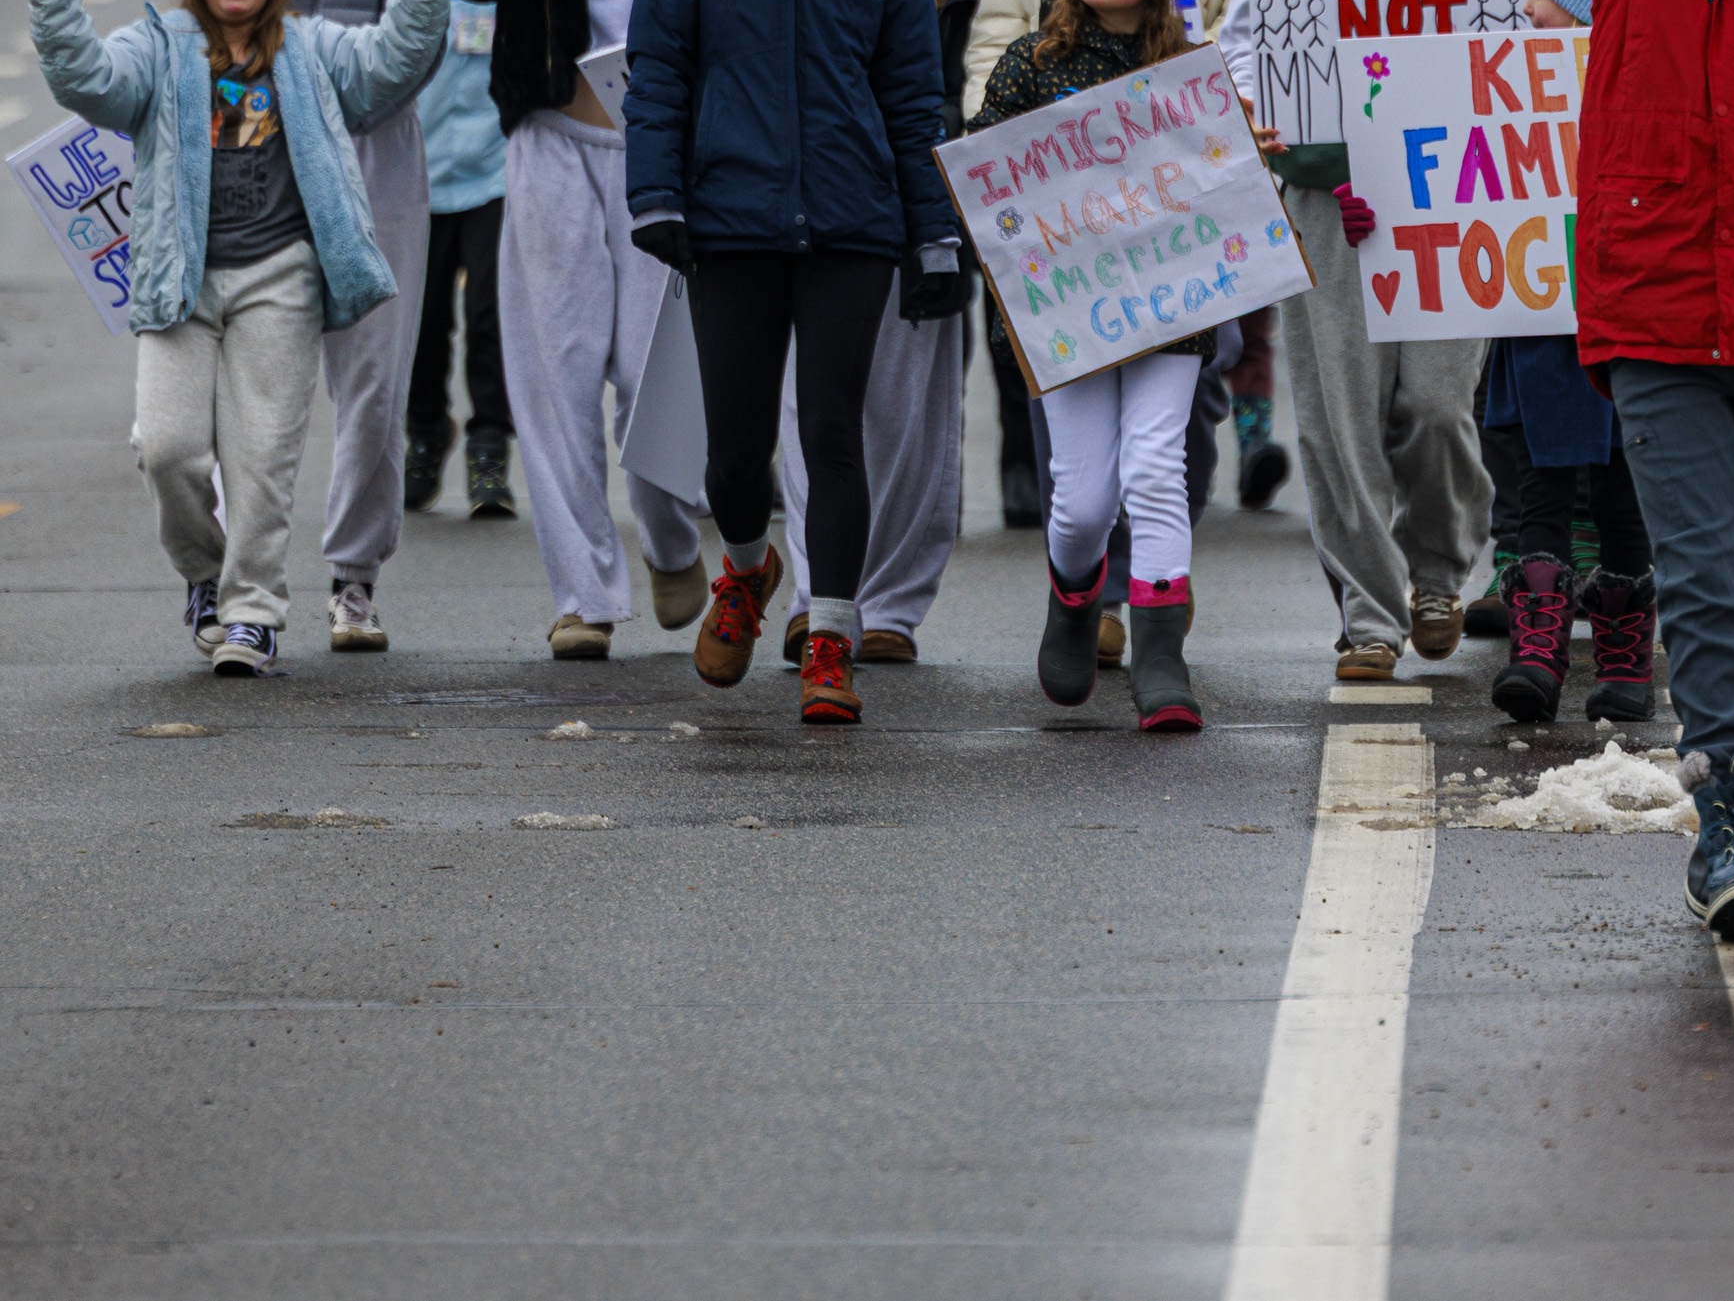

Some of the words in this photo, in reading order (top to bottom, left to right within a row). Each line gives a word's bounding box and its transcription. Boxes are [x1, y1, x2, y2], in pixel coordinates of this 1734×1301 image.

[967, 71, 1232, 207] IMMIGRANTS
[1258, 46, 1344, 145] IMM
[30, 127, 120, 209] WE
[1392, 214, 1577, 312] TOG
